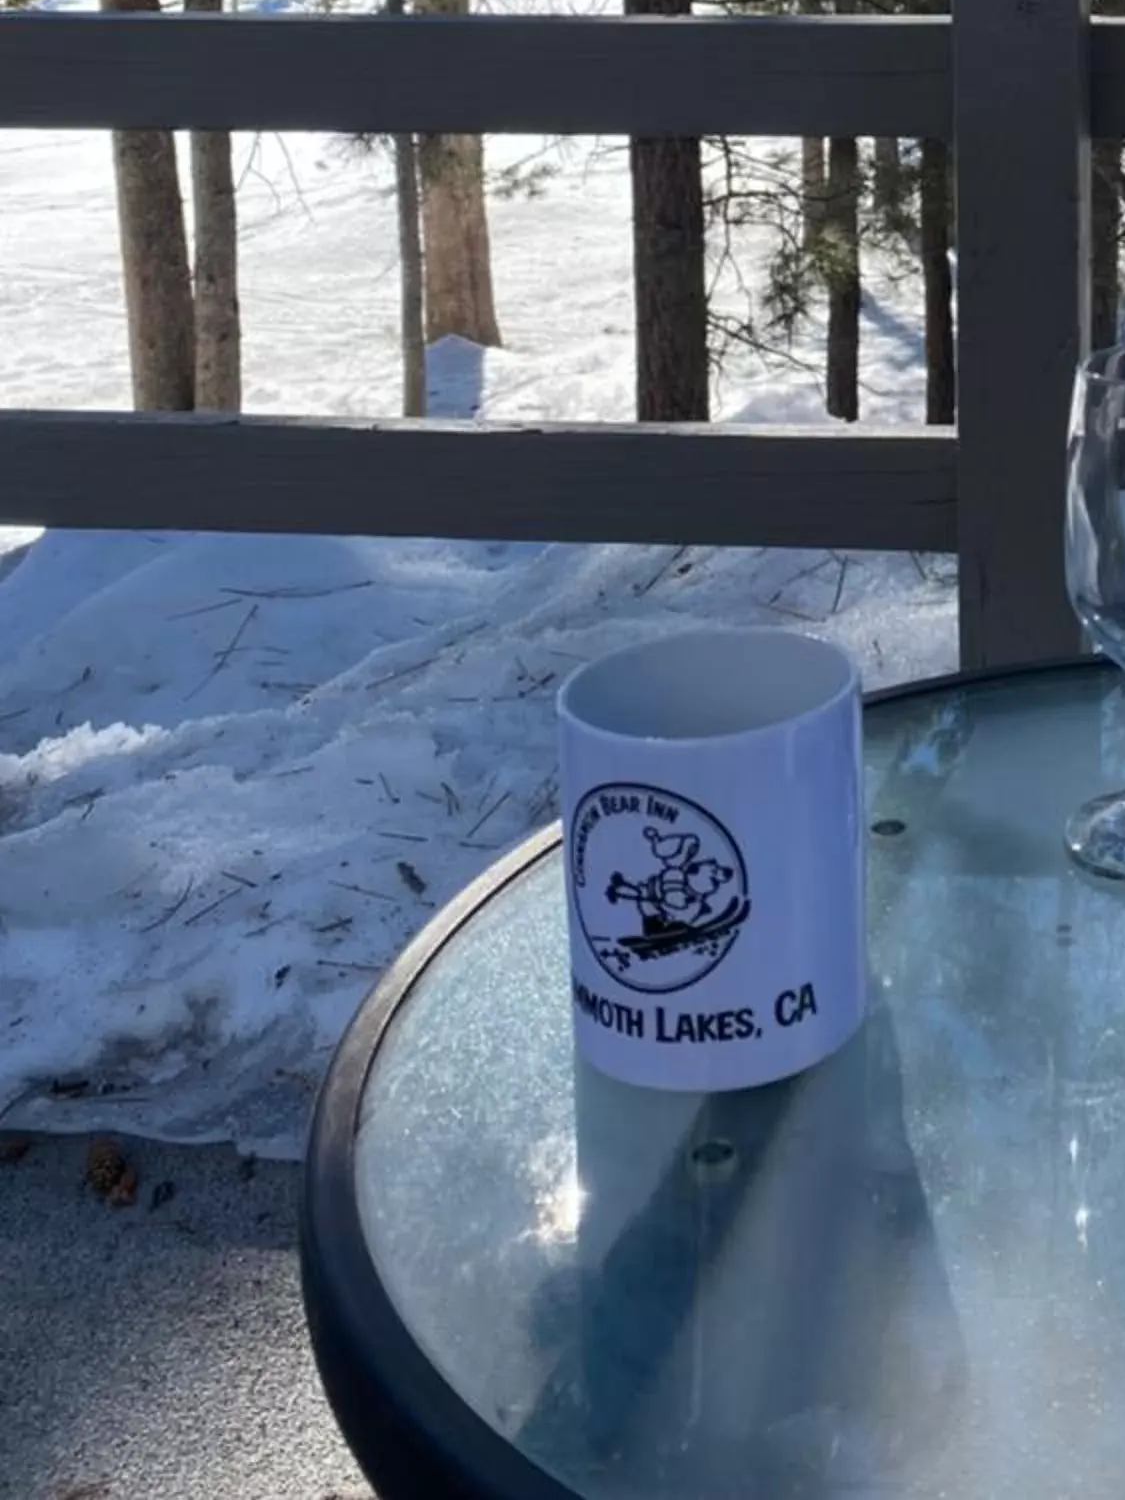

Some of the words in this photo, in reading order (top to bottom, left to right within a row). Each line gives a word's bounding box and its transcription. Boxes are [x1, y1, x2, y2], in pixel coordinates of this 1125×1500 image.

[599, 794, 641, 817] BEAR
[646, 795, 680, 825] INN
[655, 1005, 763, 1043] LAKES,
[774, 982, 818, 1027] CA
